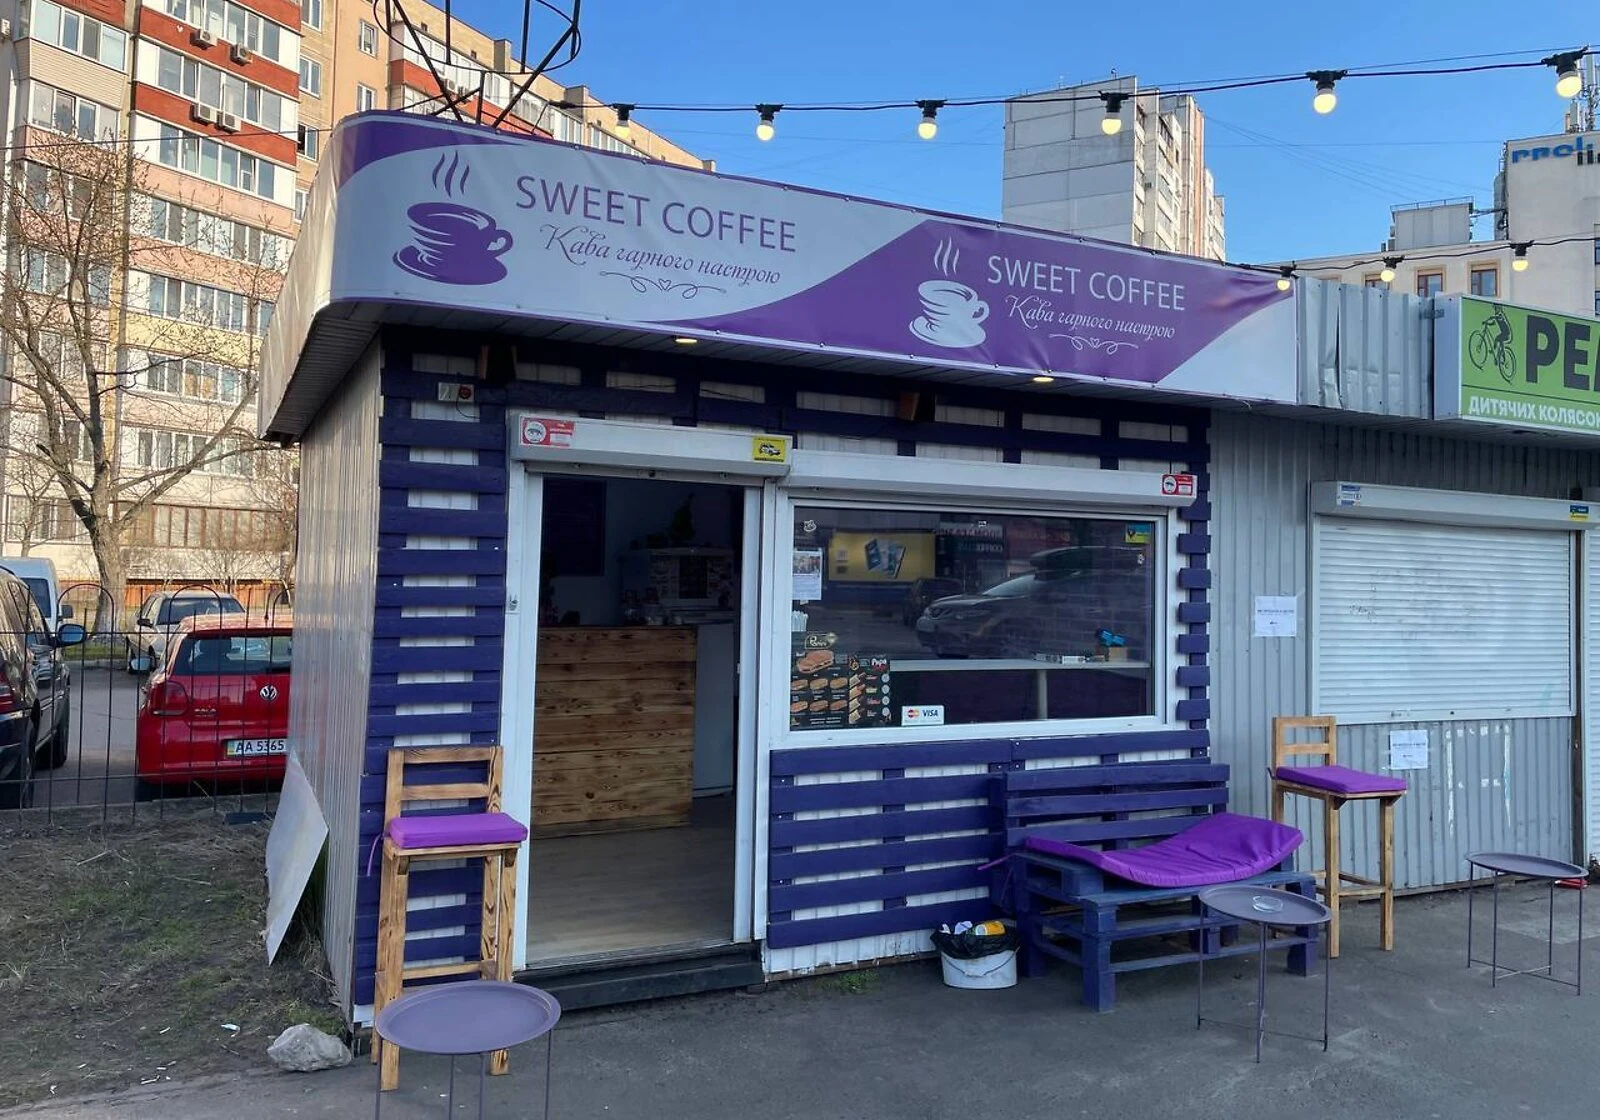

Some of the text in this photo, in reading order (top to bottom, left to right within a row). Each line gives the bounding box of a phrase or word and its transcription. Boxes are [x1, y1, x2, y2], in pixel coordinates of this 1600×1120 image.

[516, 175, 797, 253] SWEET COFFEE
[540, 224, 781, 286] Кава гарного настрою
[987, 255, 1186, 311] SWEET COFFEE
[1005, 294, 1176, 341] Кава гарного настрою
[1525, 314, 1600, 393] РЕ
[1469, 396, 1537, 420] ДИТЯЧИХ
[922, 709, 939, 718] VISA
[235, 740, 284, 753] AA 5365
